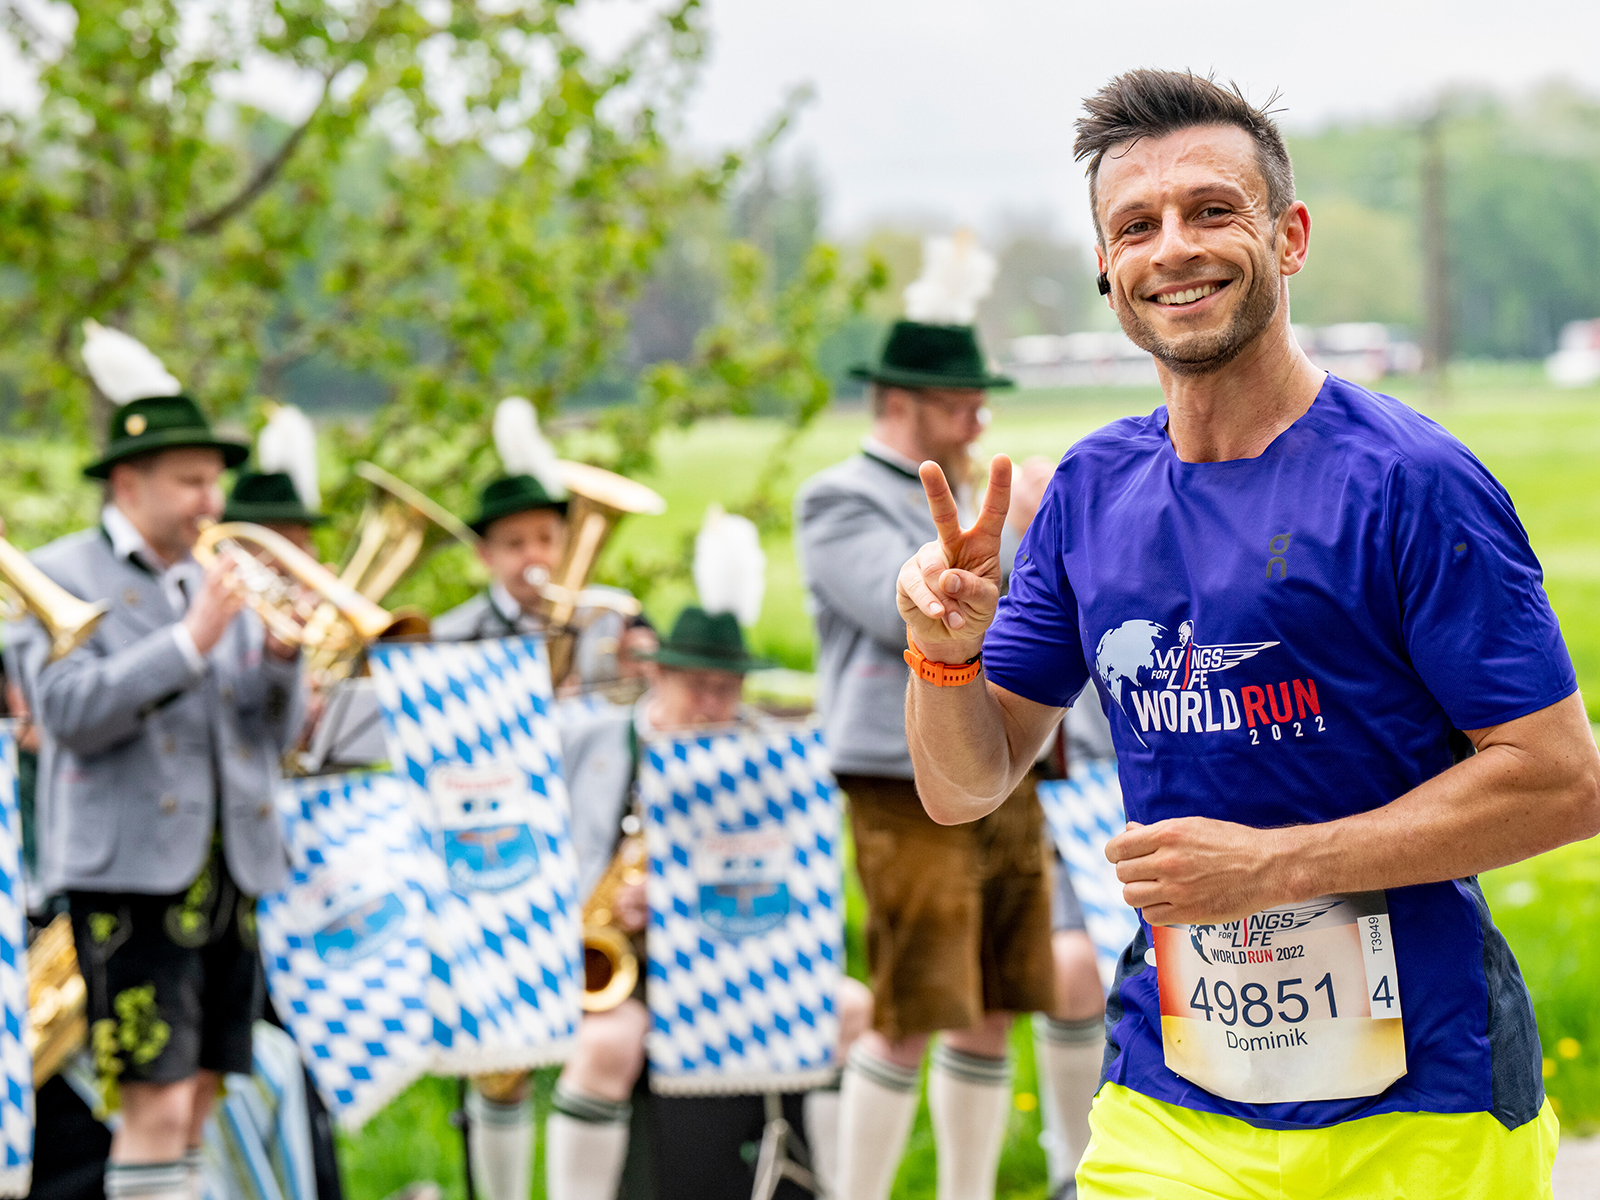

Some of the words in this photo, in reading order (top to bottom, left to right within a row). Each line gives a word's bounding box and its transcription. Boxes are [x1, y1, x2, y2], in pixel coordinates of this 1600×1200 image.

[1155, 646, 1223, 670] WINGS
[1151, 670, 1169, 680] FOR
[1167, 669, 1209, 690] LIFE
[1249, 715, 1326, 746] 2022
[1218, 931, 1232, 939] FOR
[1231, 930, 1275, 948] LIFE
[1368, 916, 1383, 954] T3949
[1276, 944, 1305, 961] 2022
[1190, 972, 1338, 1028] 49851
[1372, 975, 1395, 1009] 4
[1225, 1028, 1309, 1052] Dominik
